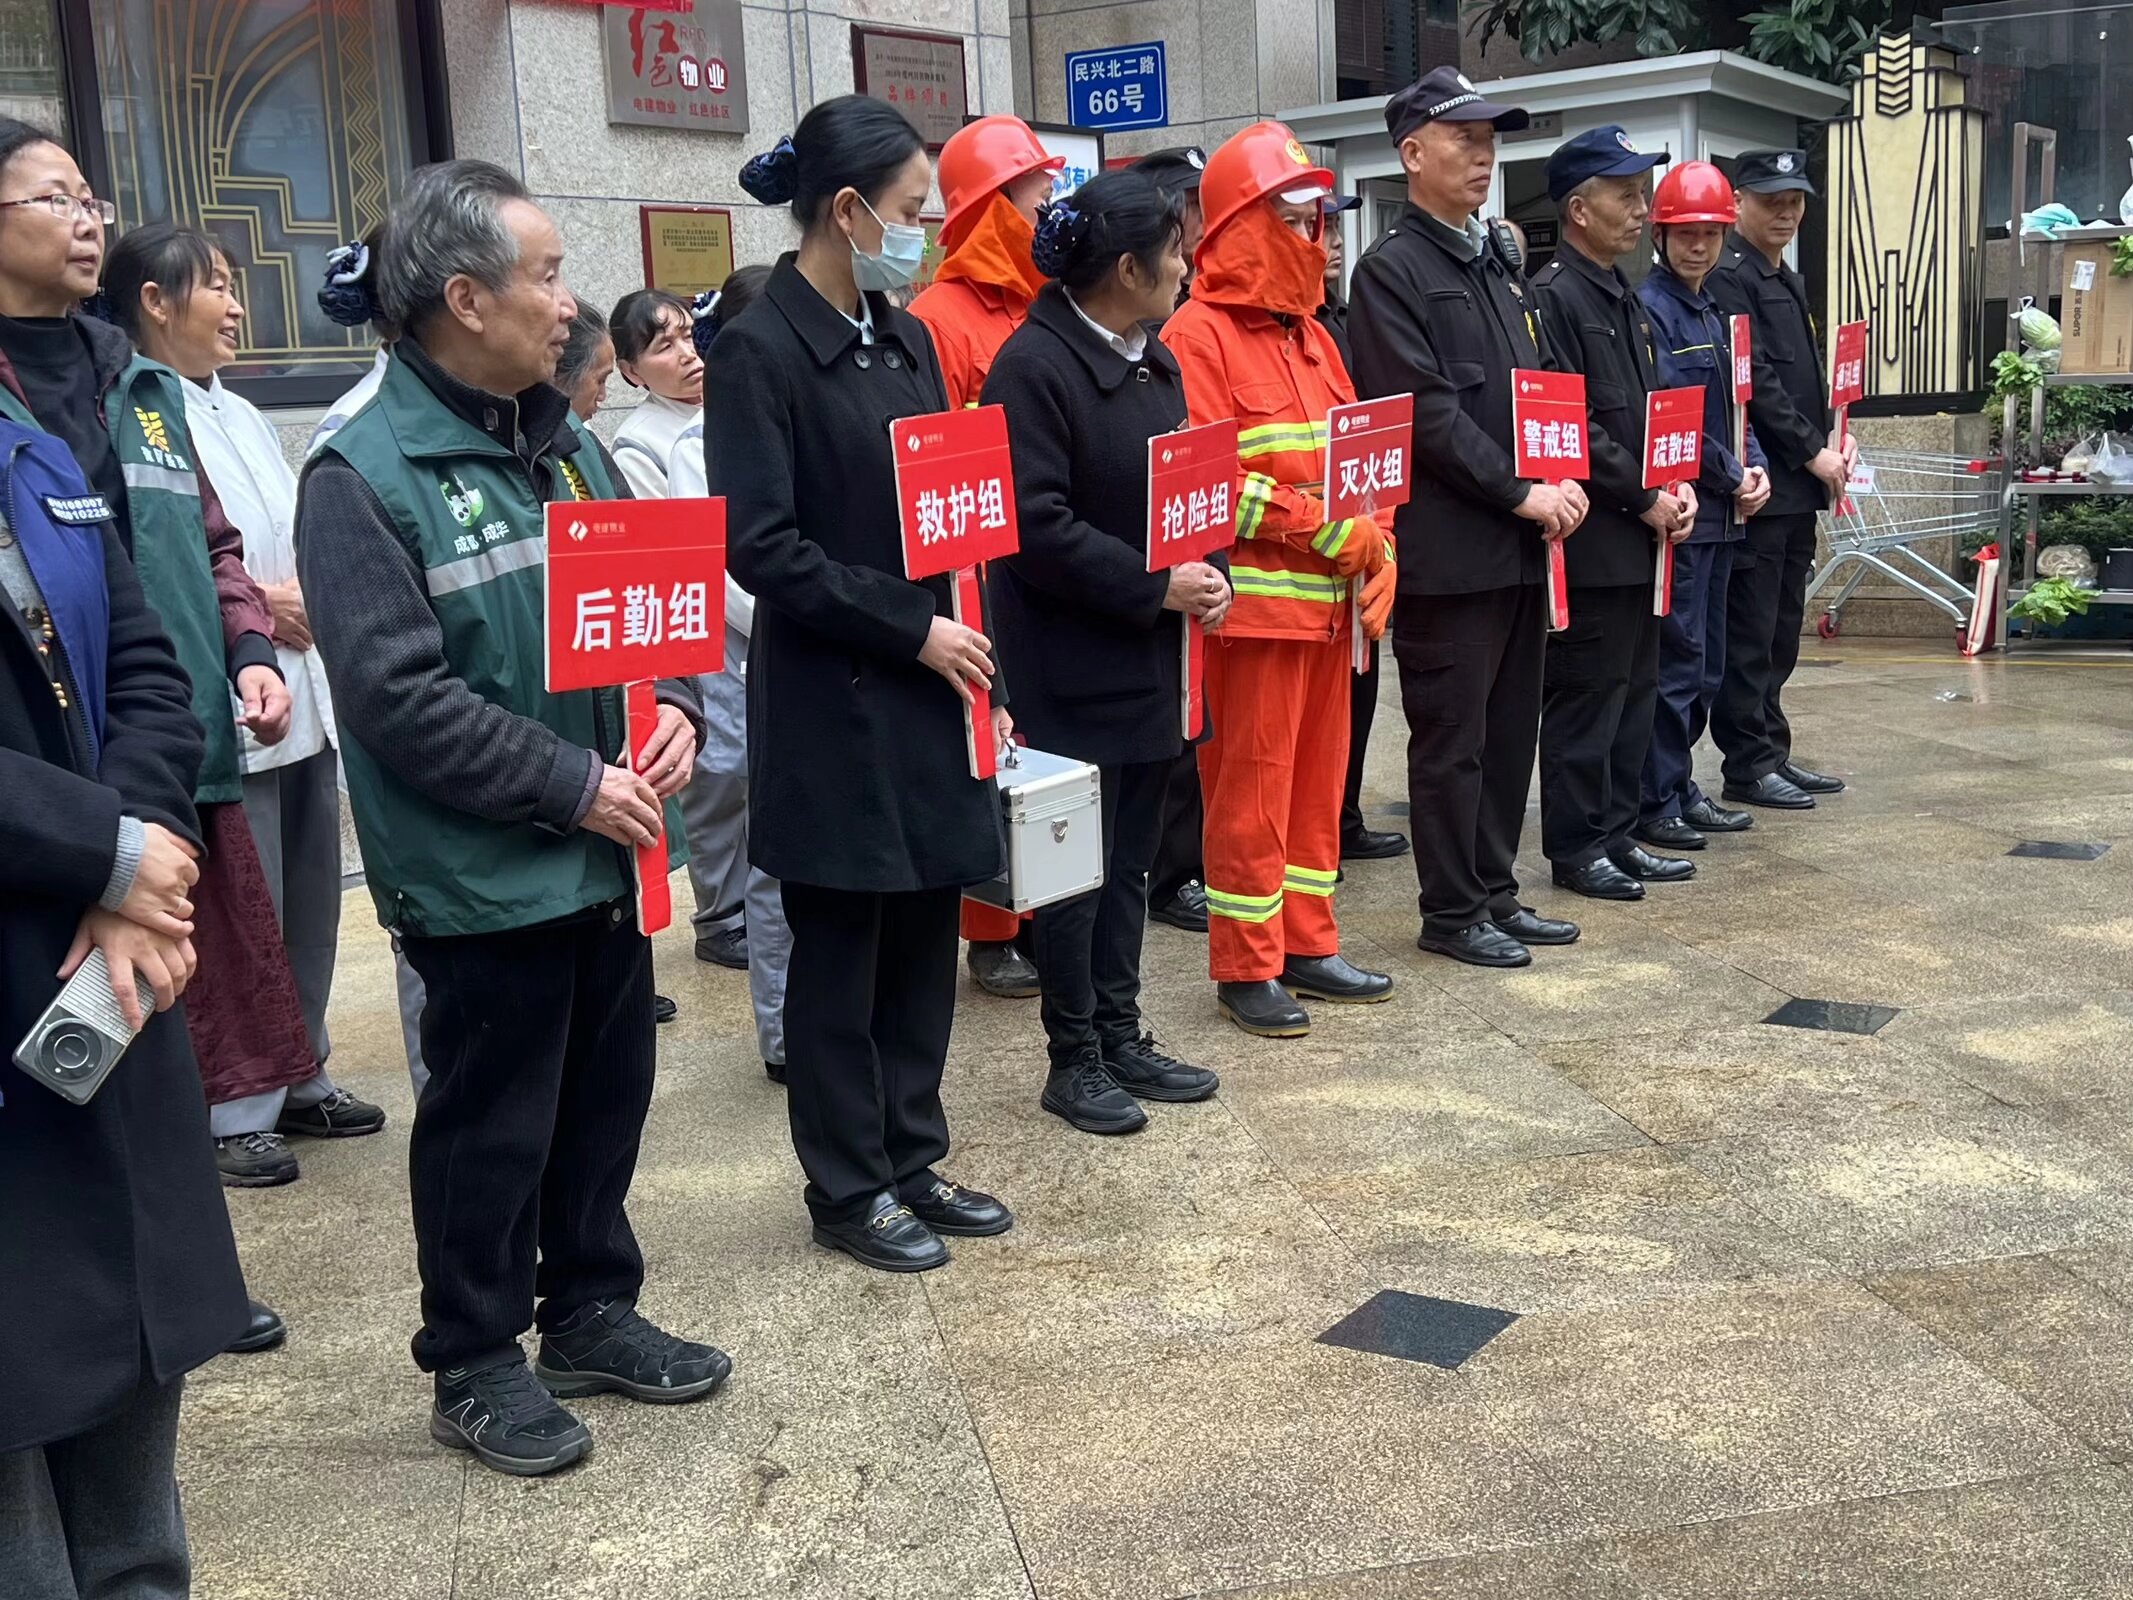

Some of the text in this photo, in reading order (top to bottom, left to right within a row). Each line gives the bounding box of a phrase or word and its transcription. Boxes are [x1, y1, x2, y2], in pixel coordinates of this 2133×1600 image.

[680, 60, 726, 89] 物业
[1075, 55, 1155, 82] 民兴北二路
[688, 104, 730, 119] 红色社区
[1089, 83, 1145, 115] 66号
[2073, 307, 2081, 337] SUPOR
[1523, 419, 1582, 459] 警戒组
[1652, 430, 1697, 468] 疏散组
[1338, 447, 1403, 500] 灭火组
[916, 477, 1007, 546] 救护组
[1161, 481, 1229, 543] 抢险组
[453, 520, 510, 554] 成都·成华
[571, 581, 709, 652] 后勤组
